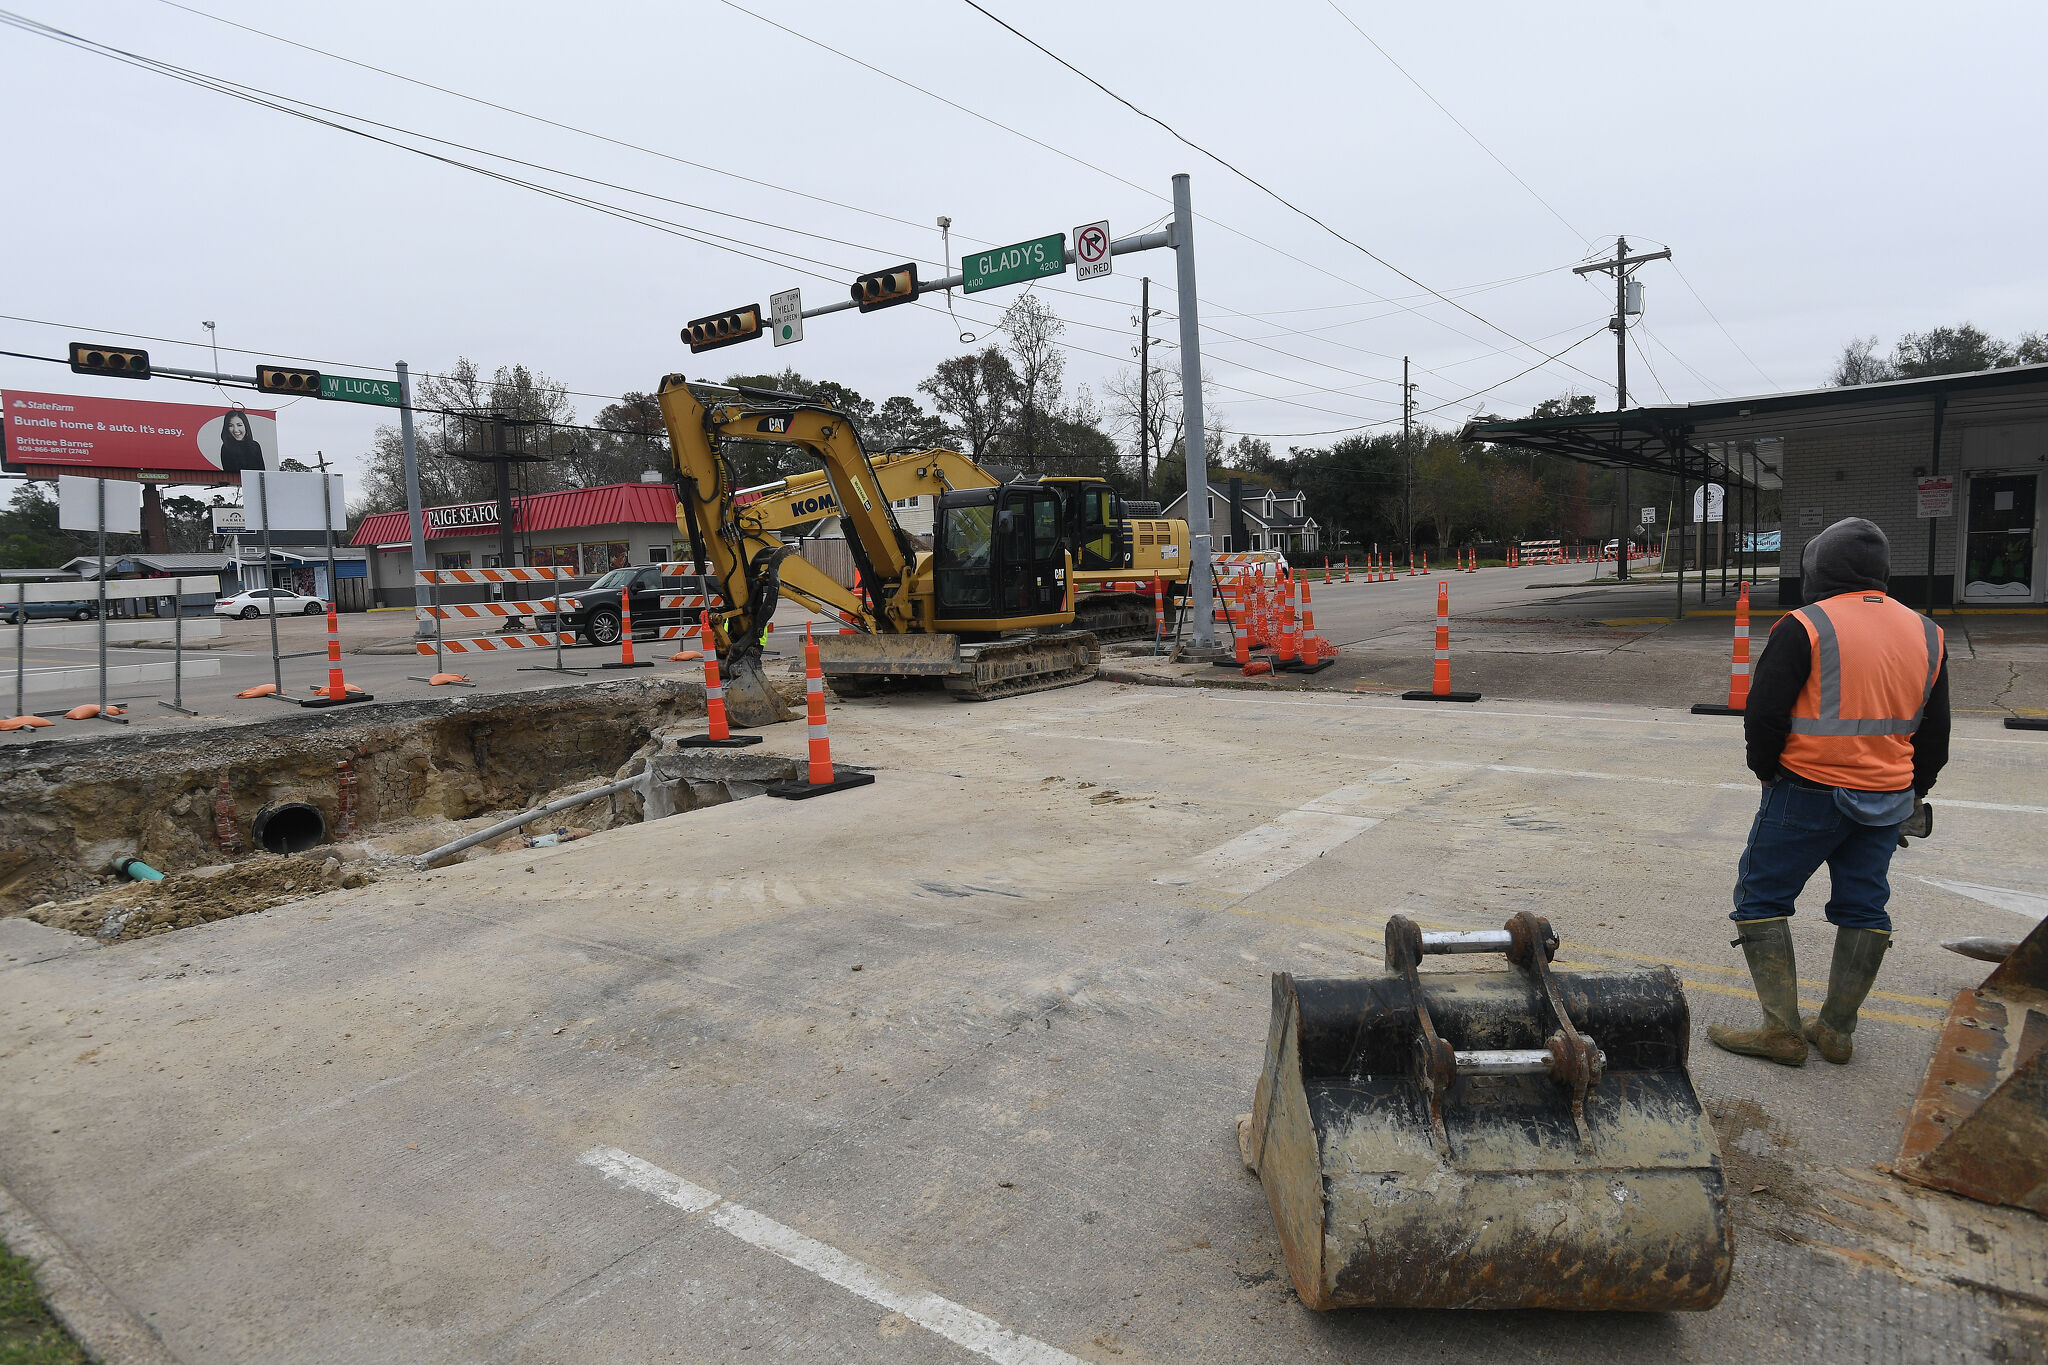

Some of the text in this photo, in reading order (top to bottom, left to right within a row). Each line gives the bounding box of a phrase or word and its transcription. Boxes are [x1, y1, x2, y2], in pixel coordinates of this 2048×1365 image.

[979, 243, 1045, 275] GLADYS
[1039, 260, 1059, 272] 4200
[1079, 262, 1109, 277] ON RED
[967, 277, 983, 287] 4100
[773, 292, 798, 306] LEFT TURN
[778, 303, 795, 314] YIELD
[784, 313, 798, 322] GREEN
[321, 390, 336, 398] 1300
[328, 378, 390, 396] W LUCAS
[14, 416, 57, 428] Bundle
[60, 419, 94, 430] home
[97, 422, 106, 431] &
[109, 424, 137, 433] auto.
[157, 427, 185, 437] easy.
[768, 417, 785, 432] CAT
[16, 436, 94, 448] Brittnee Barnes
[791, 494, 837, 517] KOM
[428, 509, 458, 526] PAIGE
[1054, 568, 1065, 579] CAT
